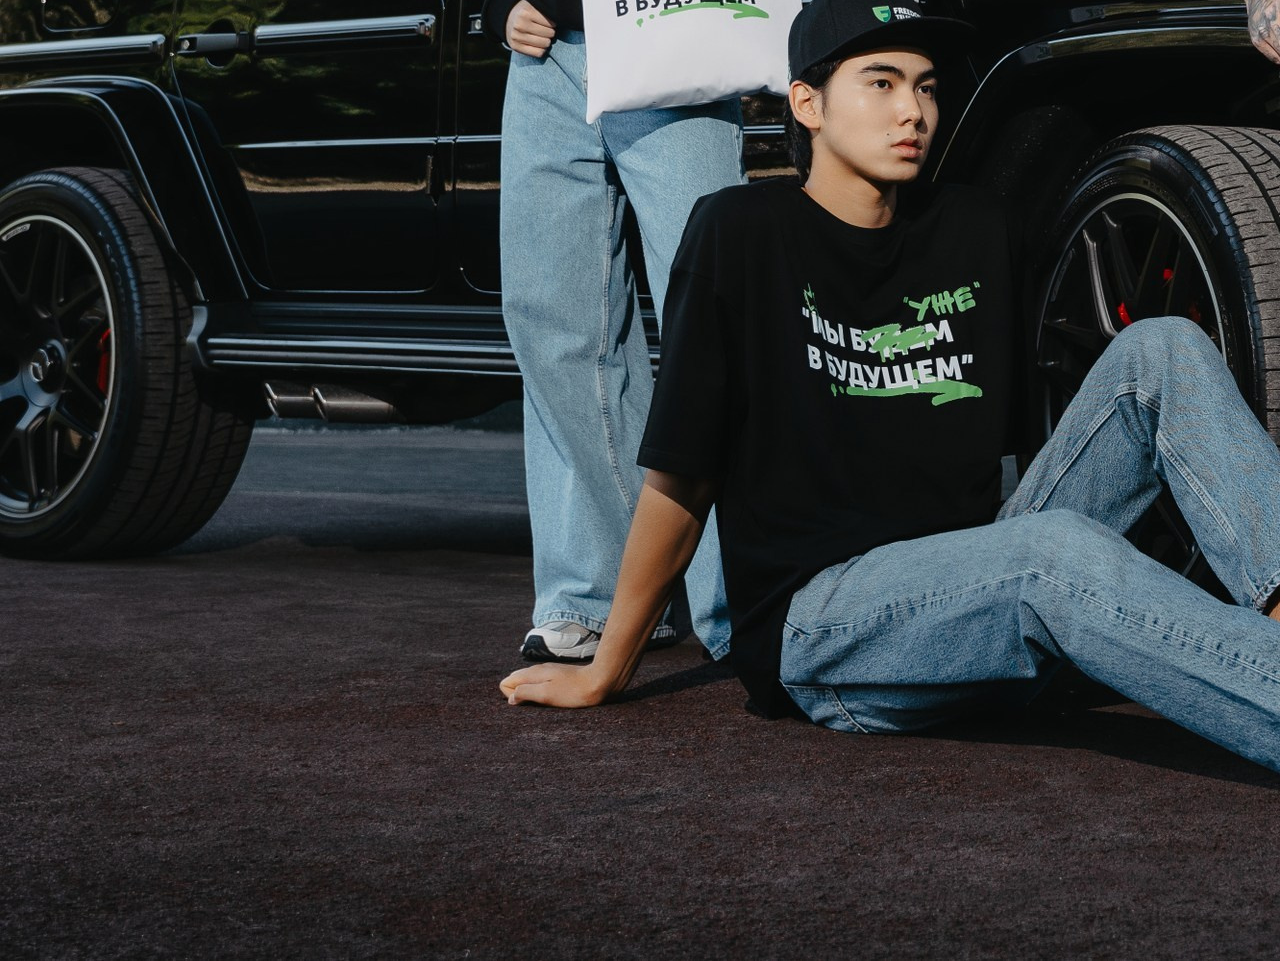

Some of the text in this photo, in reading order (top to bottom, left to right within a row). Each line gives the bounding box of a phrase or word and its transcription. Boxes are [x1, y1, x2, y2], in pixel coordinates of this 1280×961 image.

[615, 0, 629, 17] В
[807, 343, 973, 391] В БУДУЩЕМ"
